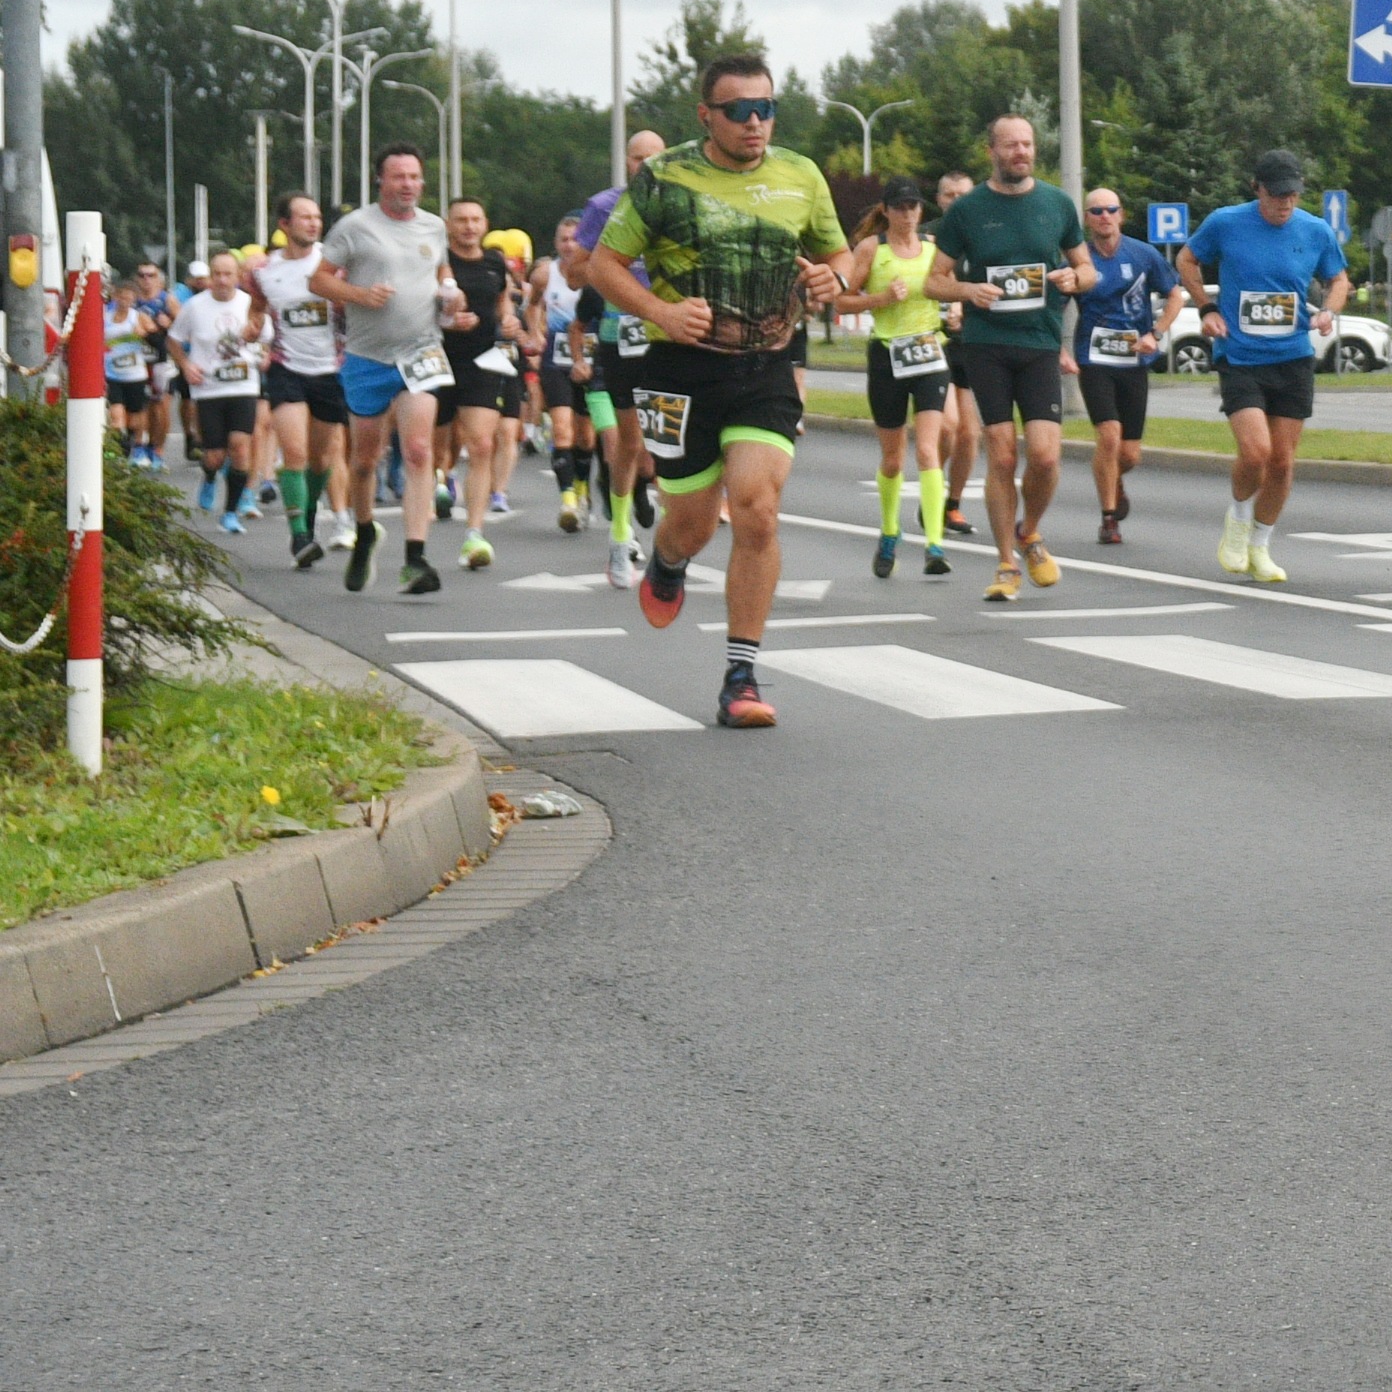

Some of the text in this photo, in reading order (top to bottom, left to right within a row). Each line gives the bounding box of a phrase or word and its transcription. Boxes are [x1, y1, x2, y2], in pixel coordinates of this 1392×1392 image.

[1156, 207, 1182, 239] P
[1004, 278, 1030, 295] 90
[1250, 304, 1285, 321] 836
[901, 343, 935, 362] 133
[1100, 338, 1129, 353] 258
